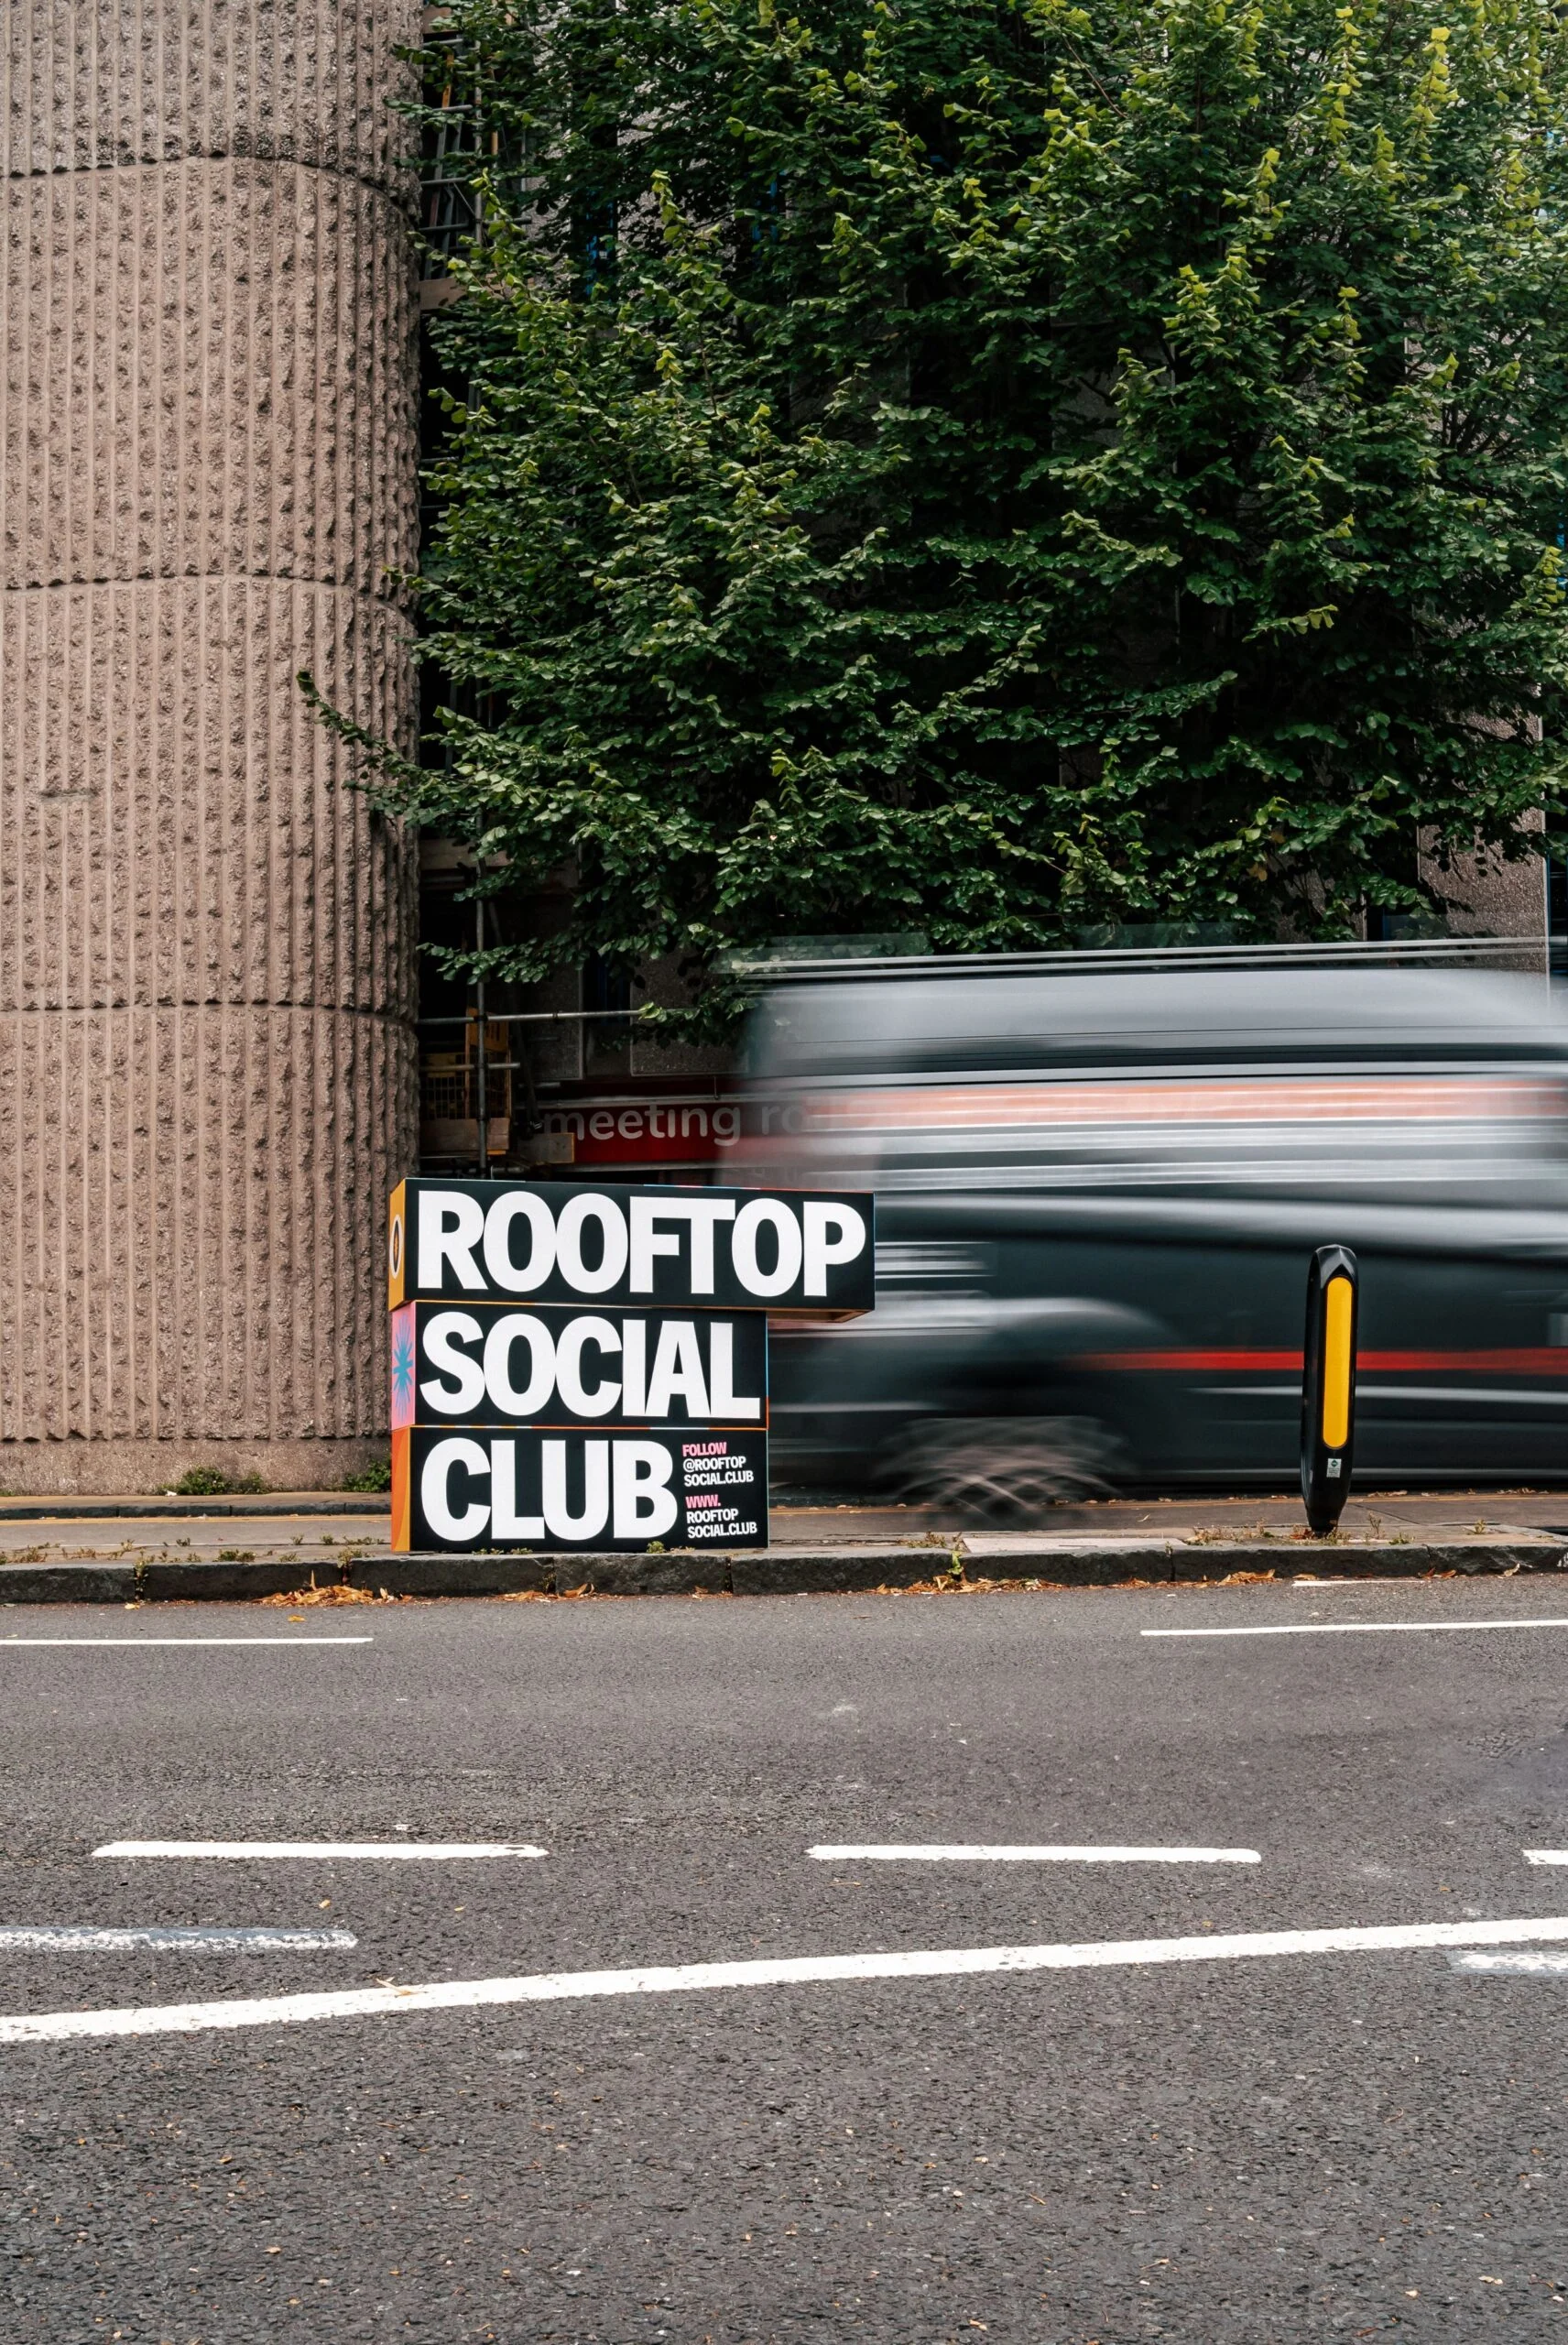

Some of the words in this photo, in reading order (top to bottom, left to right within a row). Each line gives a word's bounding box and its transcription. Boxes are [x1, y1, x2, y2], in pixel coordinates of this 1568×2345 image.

[543, 1104, 741, 1146] meeting
[418, 1190, 866, 1297] ROOFTOP
[419, 1311, 761, 1419] SOCIAL
[682, 1442, 727, 1457] FOLLOW
[682, 1456, 746, 1473] @ROOFTOP
[683, 1470, 755, 1487] SOCIAL.CLUB
[420, 1437, 679, 1541] CLUB
[685, 1494, 722, 1509] WWW.
[686, 1509, 739, 1524] ROOFTOP
[687, 1522, 758, 1539] SOCIAL.CLUB
